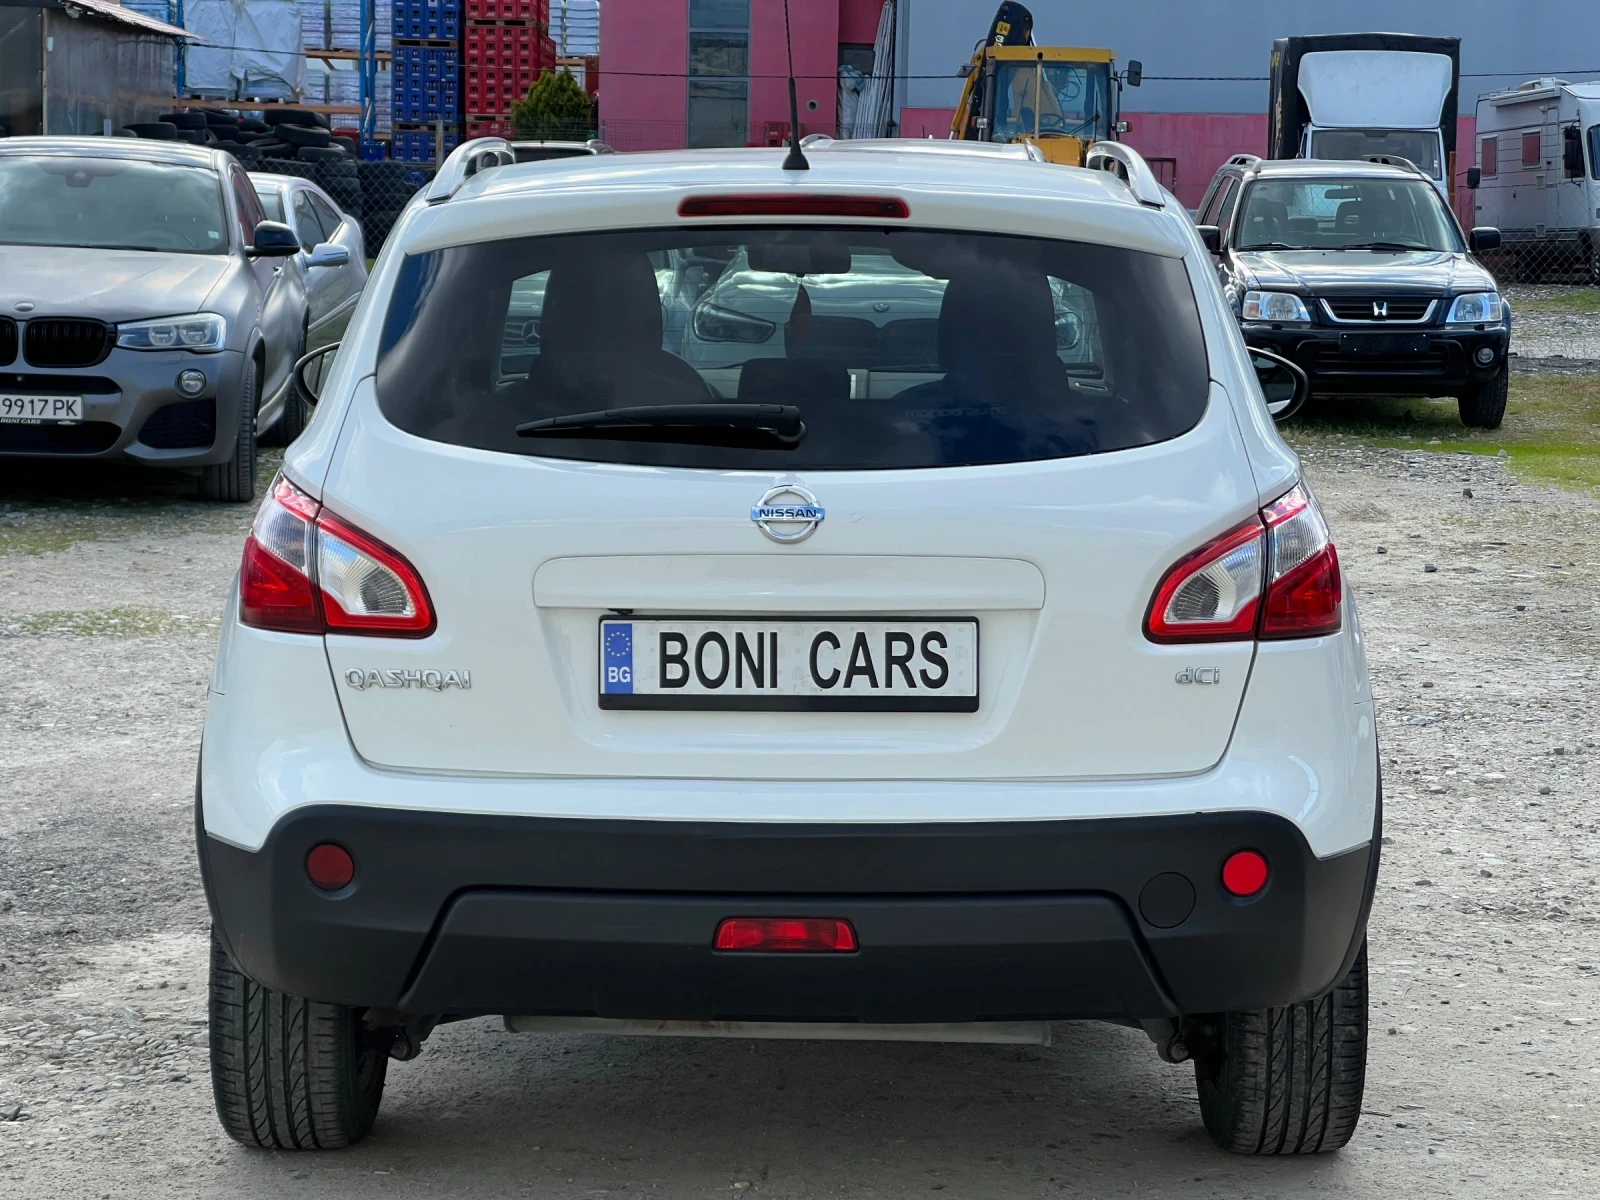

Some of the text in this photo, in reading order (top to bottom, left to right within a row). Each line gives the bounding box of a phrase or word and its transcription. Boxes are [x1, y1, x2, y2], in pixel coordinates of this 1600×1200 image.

[759, 508, 817, 518] NISSAN
[659, 631, 949, 689] BONI CARS
[345, 667, 471, 692] QASHQAI
[607, 666, 631, 683] BG
